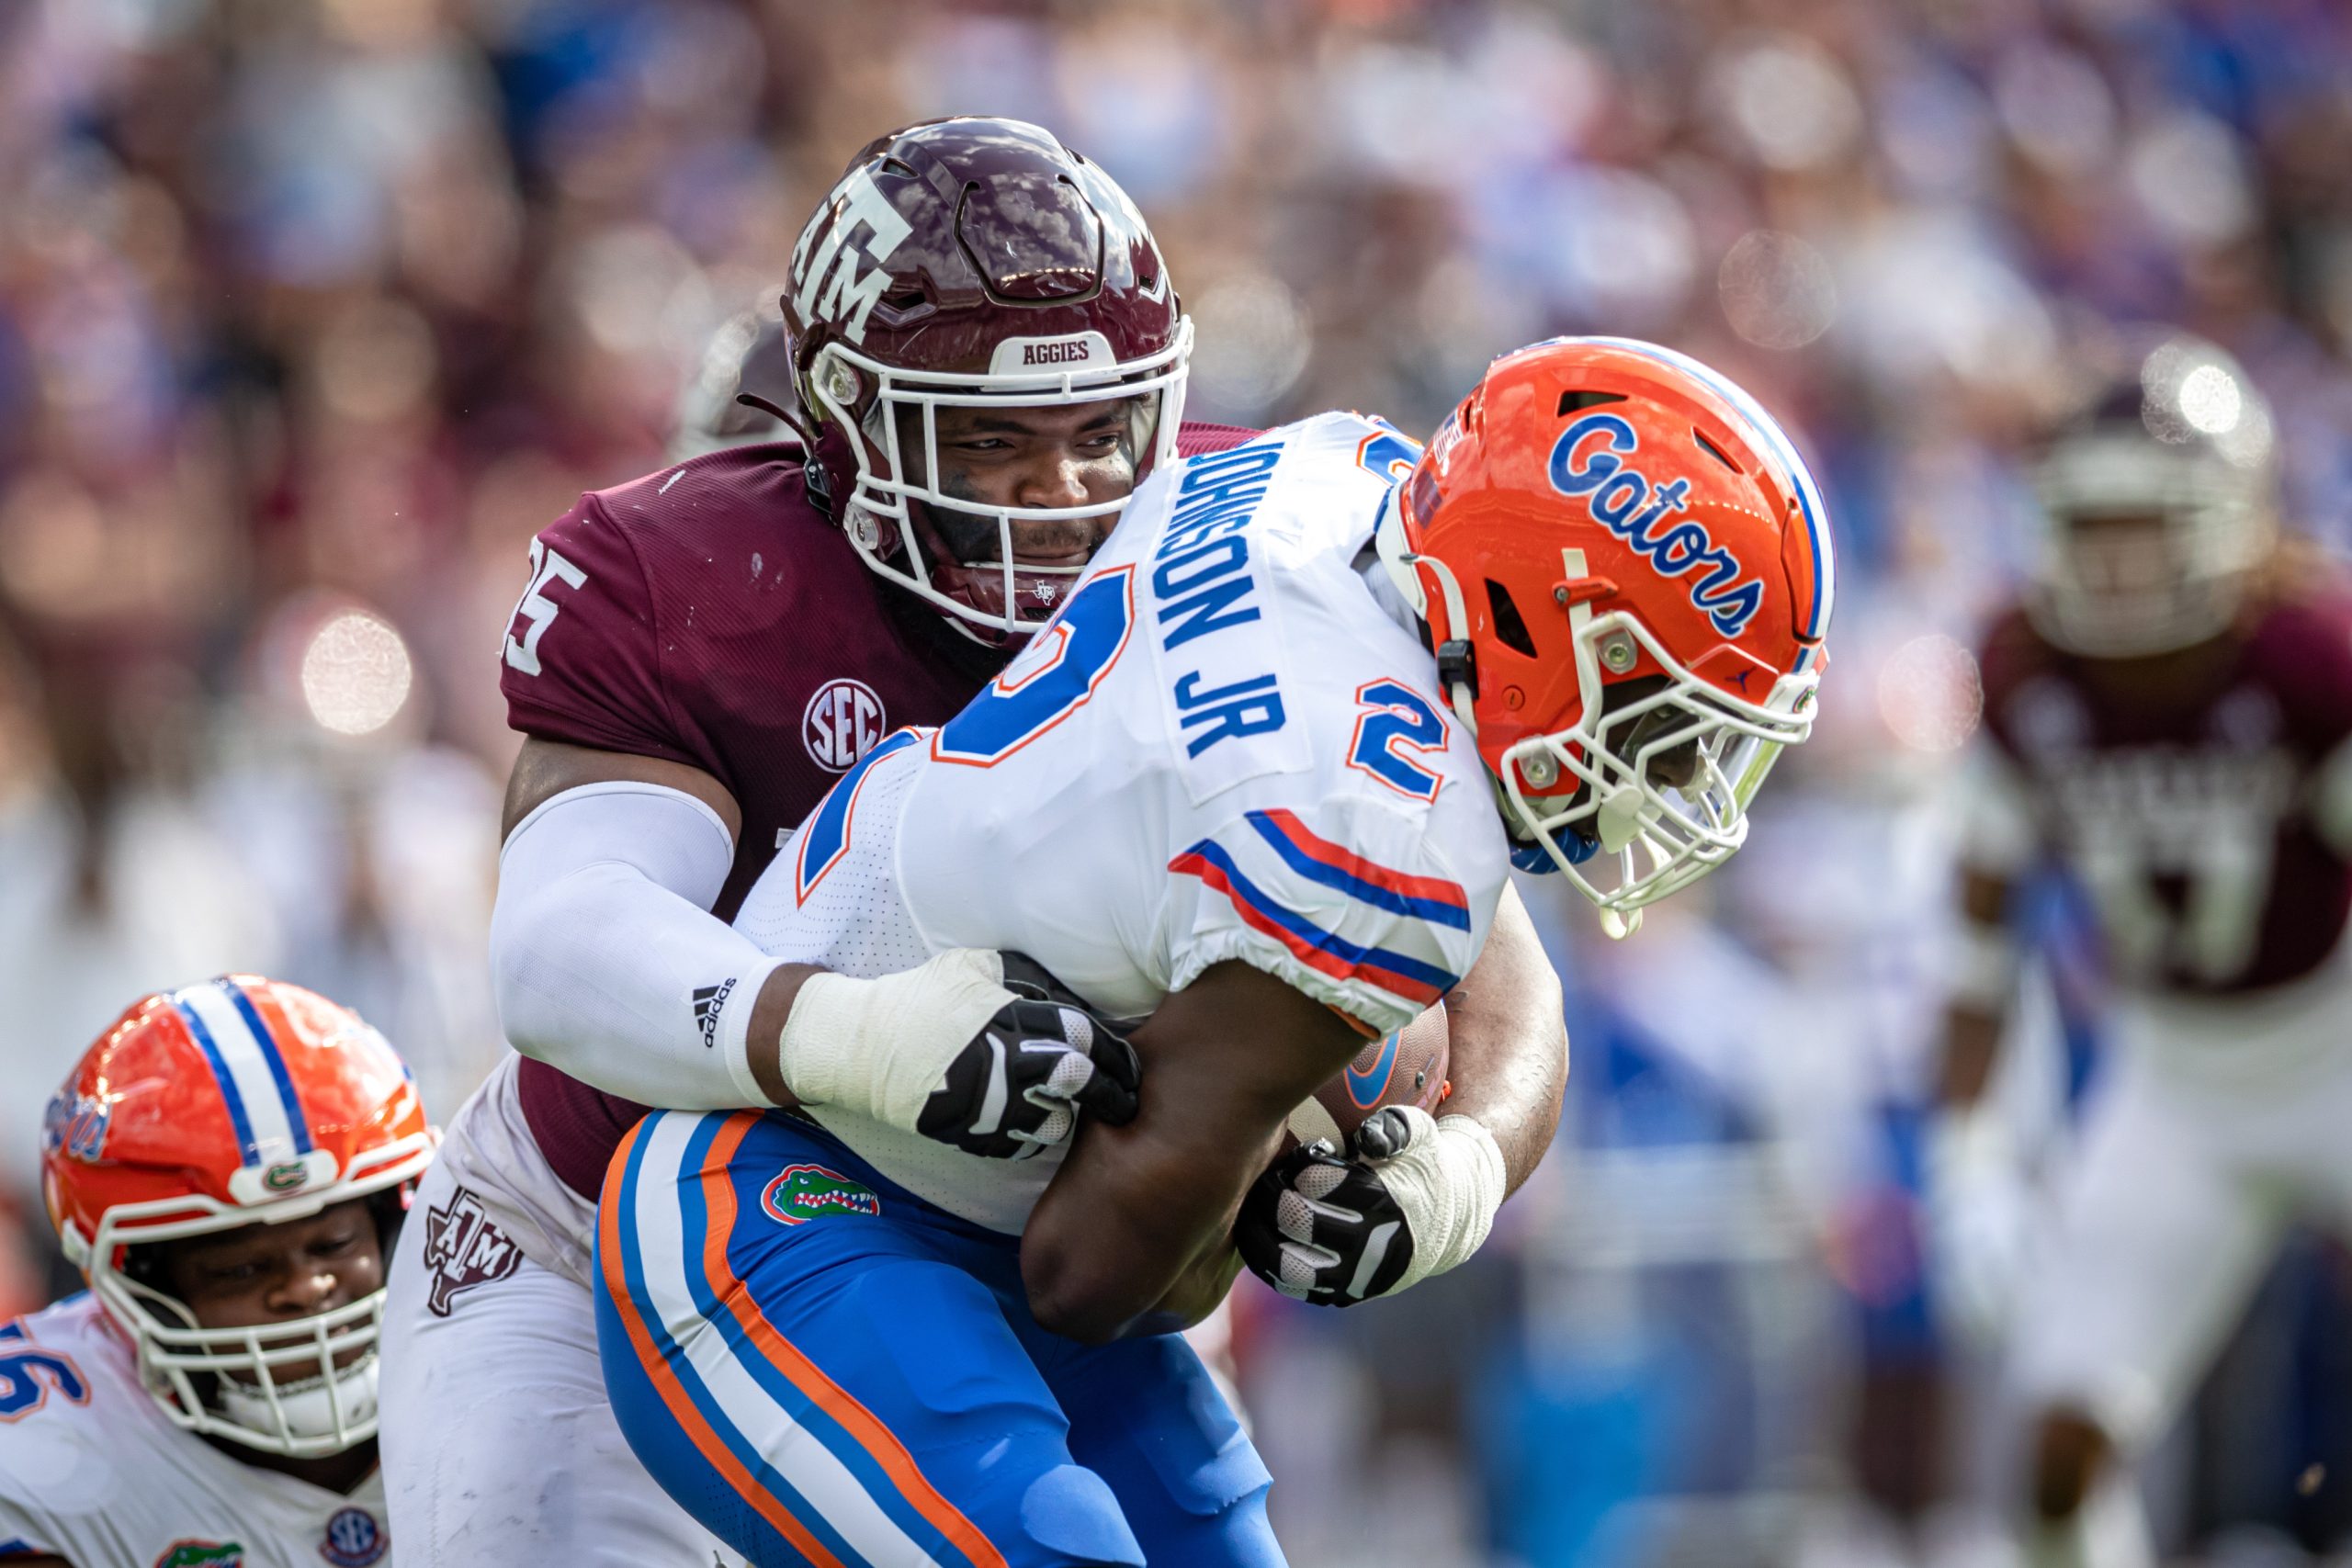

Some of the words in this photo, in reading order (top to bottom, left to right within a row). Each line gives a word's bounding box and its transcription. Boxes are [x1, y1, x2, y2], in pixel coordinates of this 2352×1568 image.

[1022, 339, 1090, 367] AGGIES
[1151, 441, 1286, 653] JOHNSON
[1548, 413, 1764, 639] Gators
[809, 685, 879, 768] SEC
[1172, 670, 1287, 761] JR
[1345, 676, 1451, 806] 2
[704, 977, 737, 1049] adidas
